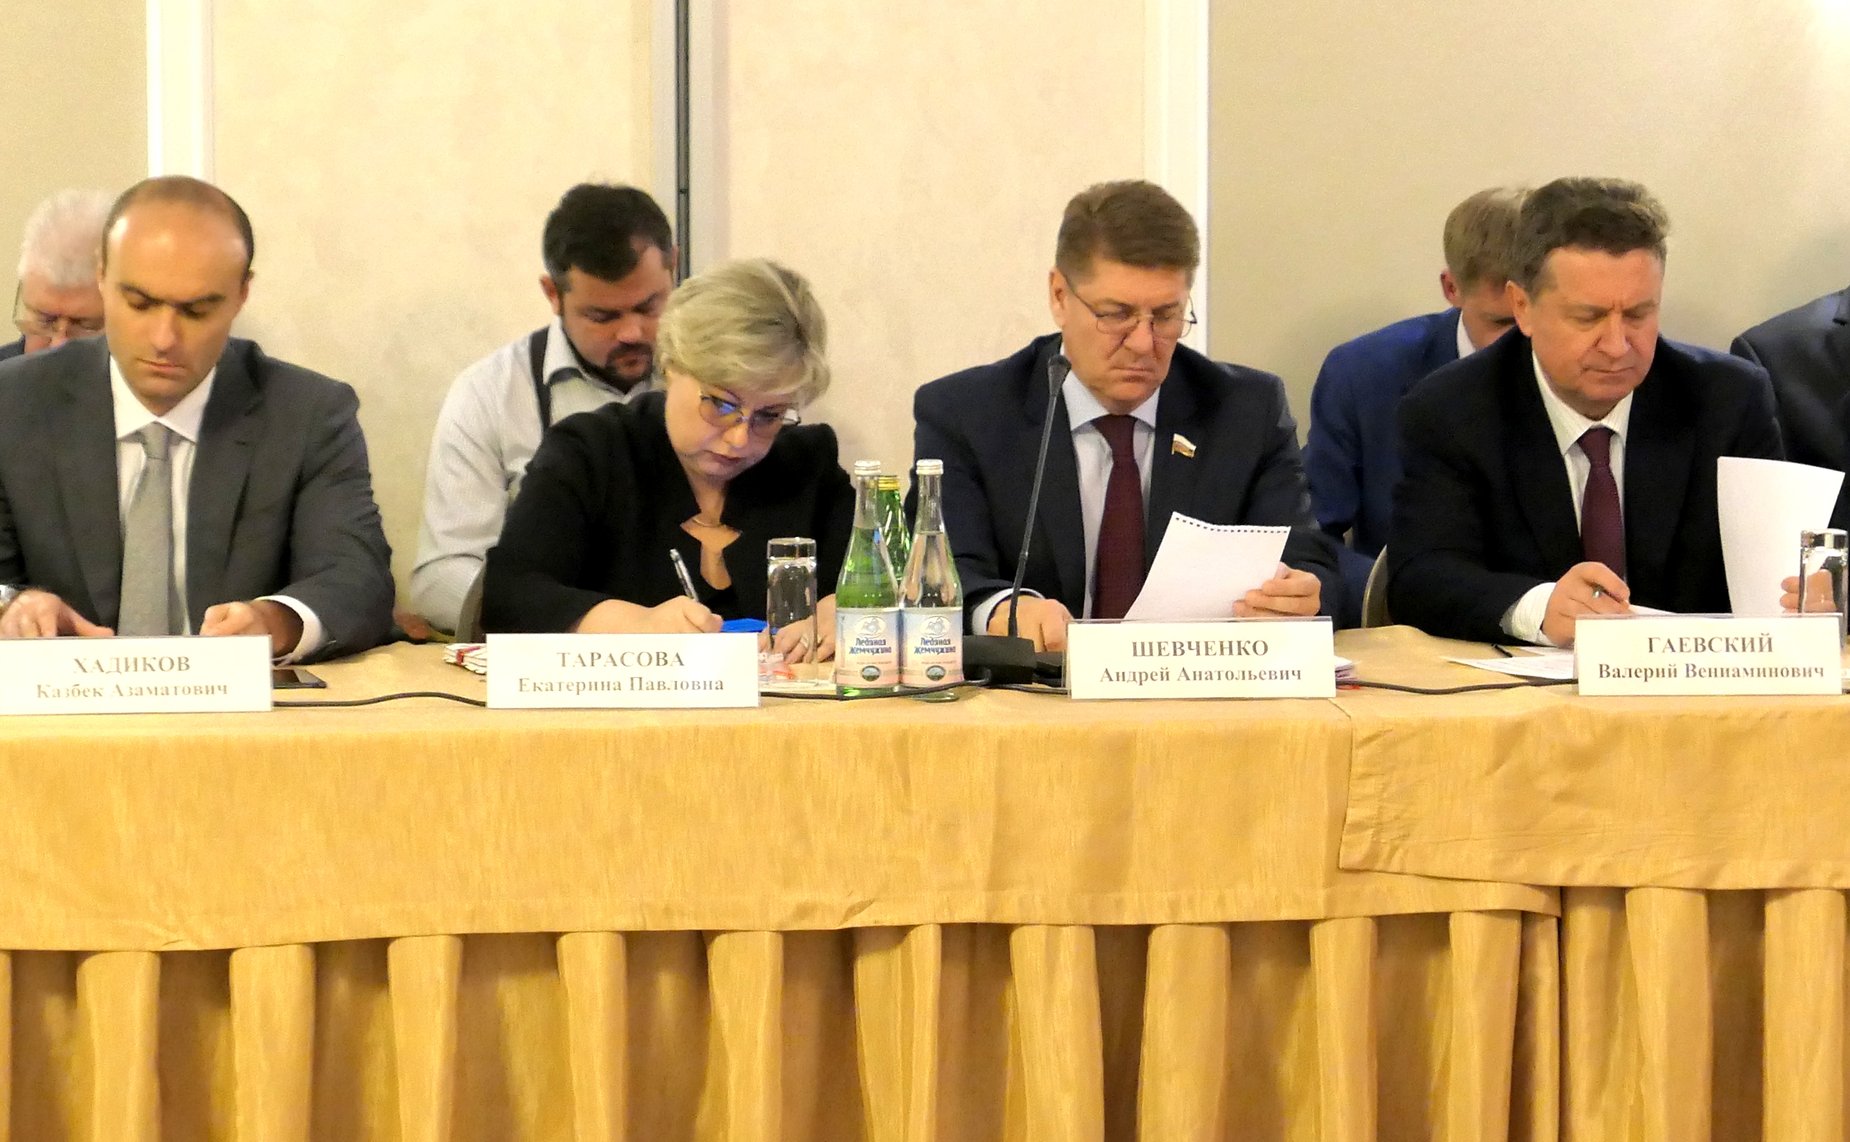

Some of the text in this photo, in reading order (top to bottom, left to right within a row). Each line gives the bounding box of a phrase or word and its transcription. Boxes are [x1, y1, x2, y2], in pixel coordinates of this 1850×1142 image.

[1131, 639, 1269, 658] ШЕВЧЕНКО
[1647, 632, 1774, 654] ГАЕВСКИЙ
[73, 656, 191, 674] ХАДИКОВ
[556, 651, 685, 668] ТАРАСОВА
[1100, 665, 1302, 686] Андрей Анатольевич
[1598, 663, 1825, 683] Валерий Вениаминович
[36, 682, 228, 699] Казбек Азаматович
[518, 676, 725, 696] Екатерина Павловна
